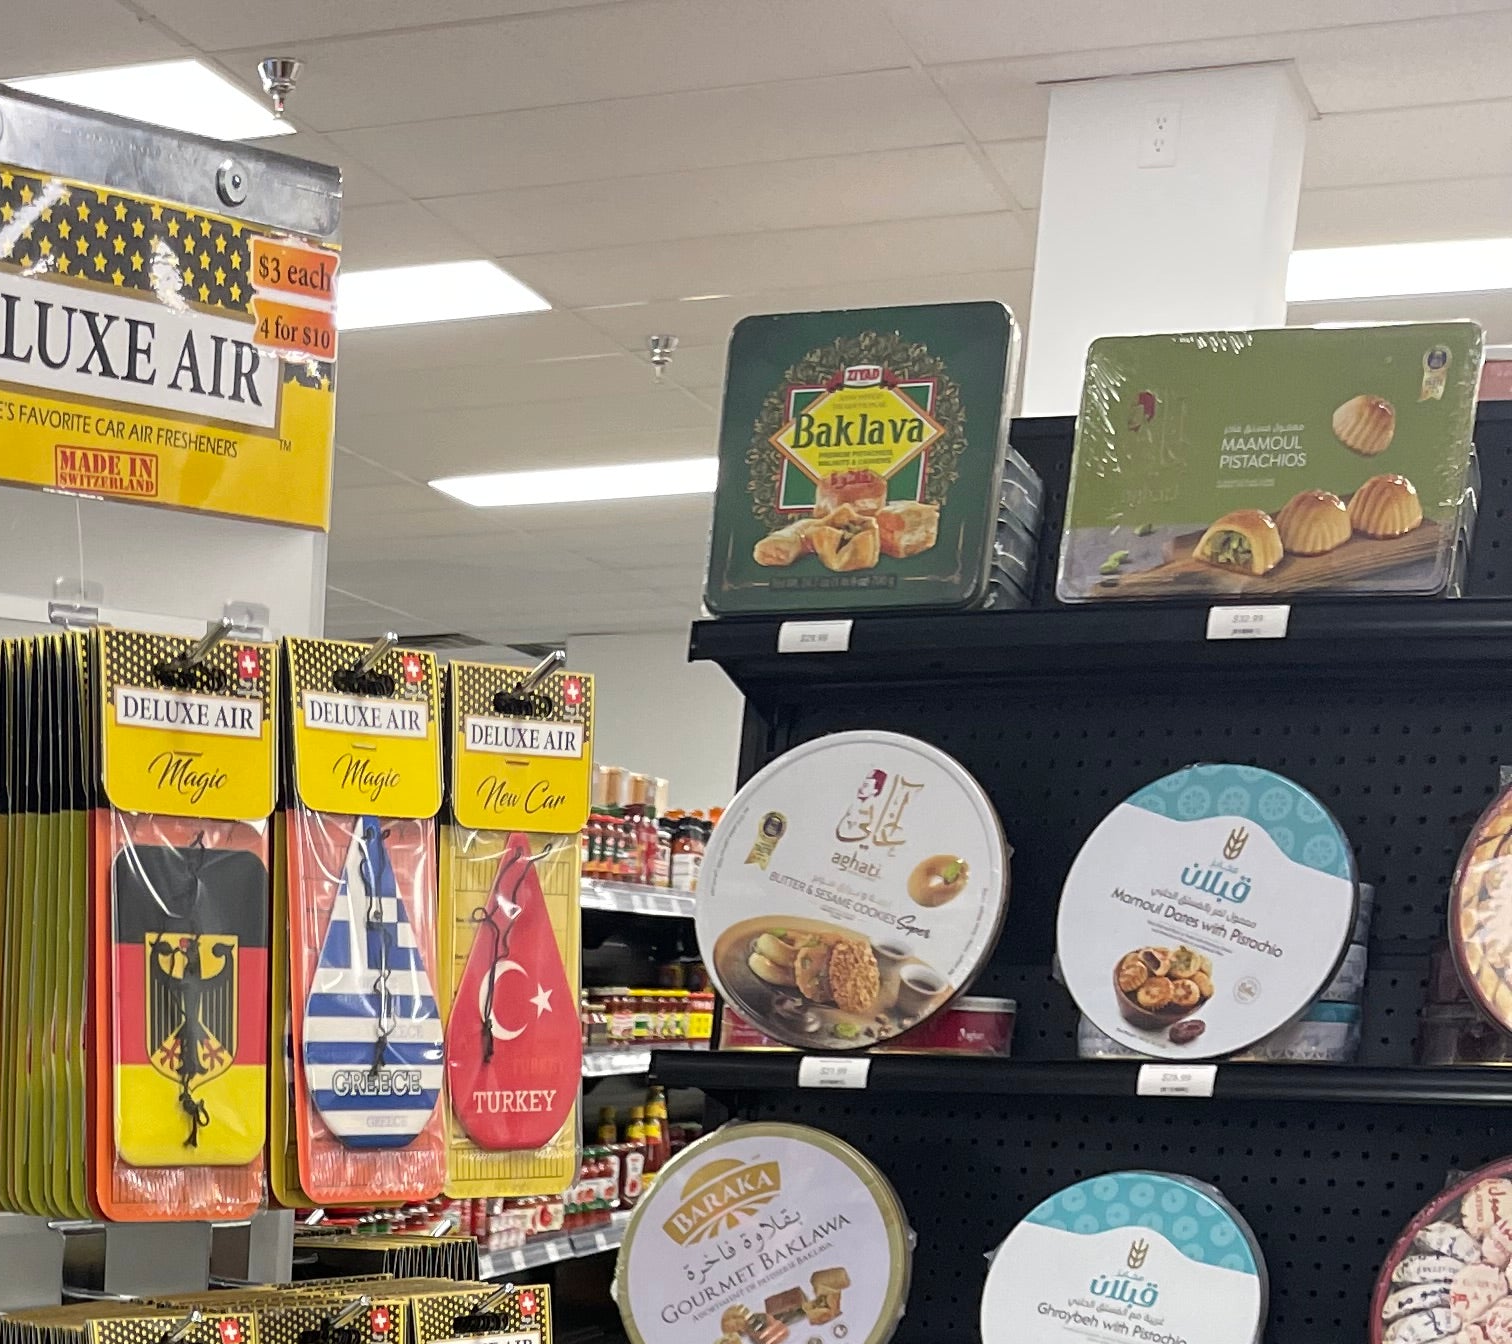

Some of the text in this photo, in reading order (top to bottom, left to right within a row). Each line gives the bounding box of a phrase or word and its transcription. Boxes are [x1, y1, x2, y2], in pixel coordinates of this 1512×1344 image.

[258, 253, 331, 293] $3 each
[260, 317, 330, 350] 4 for $10
[168, 329, 263, 407] AIR
[847, 369, 880, 381] ZIYAD
[19, 406, 91, 435] FAVORITE
[95, 418, 124, 440] CAR
[129, 423, 153, 444] AIR
[157, 428, 238, 457] FRESHENERS
[791, 413, 924, 449] Baklava
[1221, 436, 1302, 451] MAAMOUL
[59, 449, 154, 479] MADE IN
[1220, 453, 1307, 469] PISTACHIOS
[59, 471, 154, 493] SWITZERLAND
[123, 694, 255, 731] DELUXE AIR
[470, 722, 577, 754] DELUXE AIR
[147, 752, 227, 803] Magic
[475, 776, 566, 813] New Car
[831, 851, 881, 877] aghati
[769, 871, 806, 892] BUTTER
[814, 886, 852, 910] SESAME
[852, 901, 897, 925] COOKIES
[1111, 887, 1283, 958] Mamoul Dates with Pistachio
[332, 1068, 422, 1097] GREECE
[473, 1090, 556, 1113] TURKEY
[672, 1169, 774, 1235] BARAKA
[661, 1213, 851, 1324] GOURMET BAKLAWA
[1038, 1302, 1099, 1328] Ghraybeh
[1102, 1318, 1129, 1336] with
